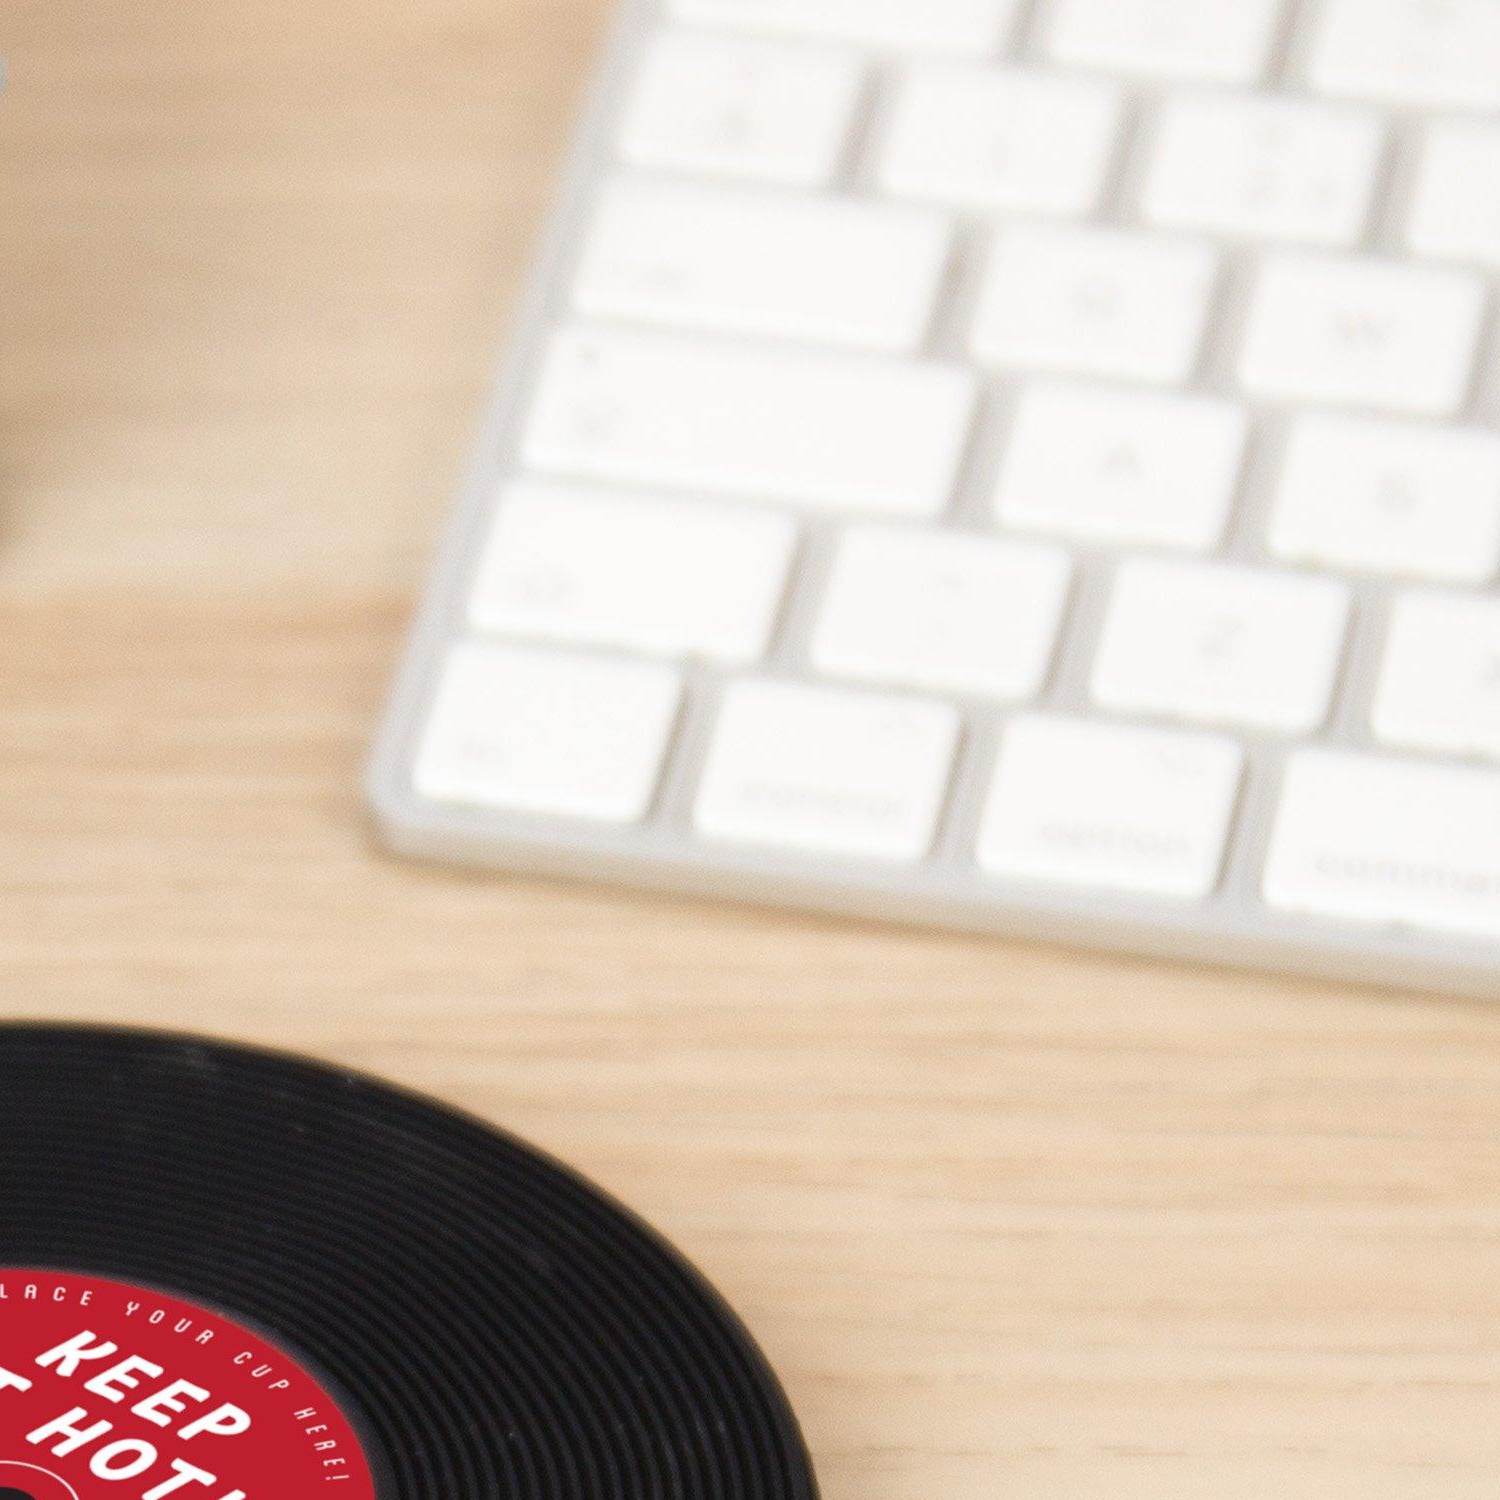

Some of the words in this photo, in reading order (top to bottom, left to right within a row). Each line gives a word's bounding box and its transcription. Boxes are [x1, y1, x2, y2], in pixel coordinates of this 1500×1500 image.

[1308, 850, 1500, 898] comma
[34, 1329, 252, 1441] KEEP
[125, 1301, 214, 1345] YOUR
[233, 1351, 290, 1391] CUP
[293, 1407, 350, 1481] HERE!
